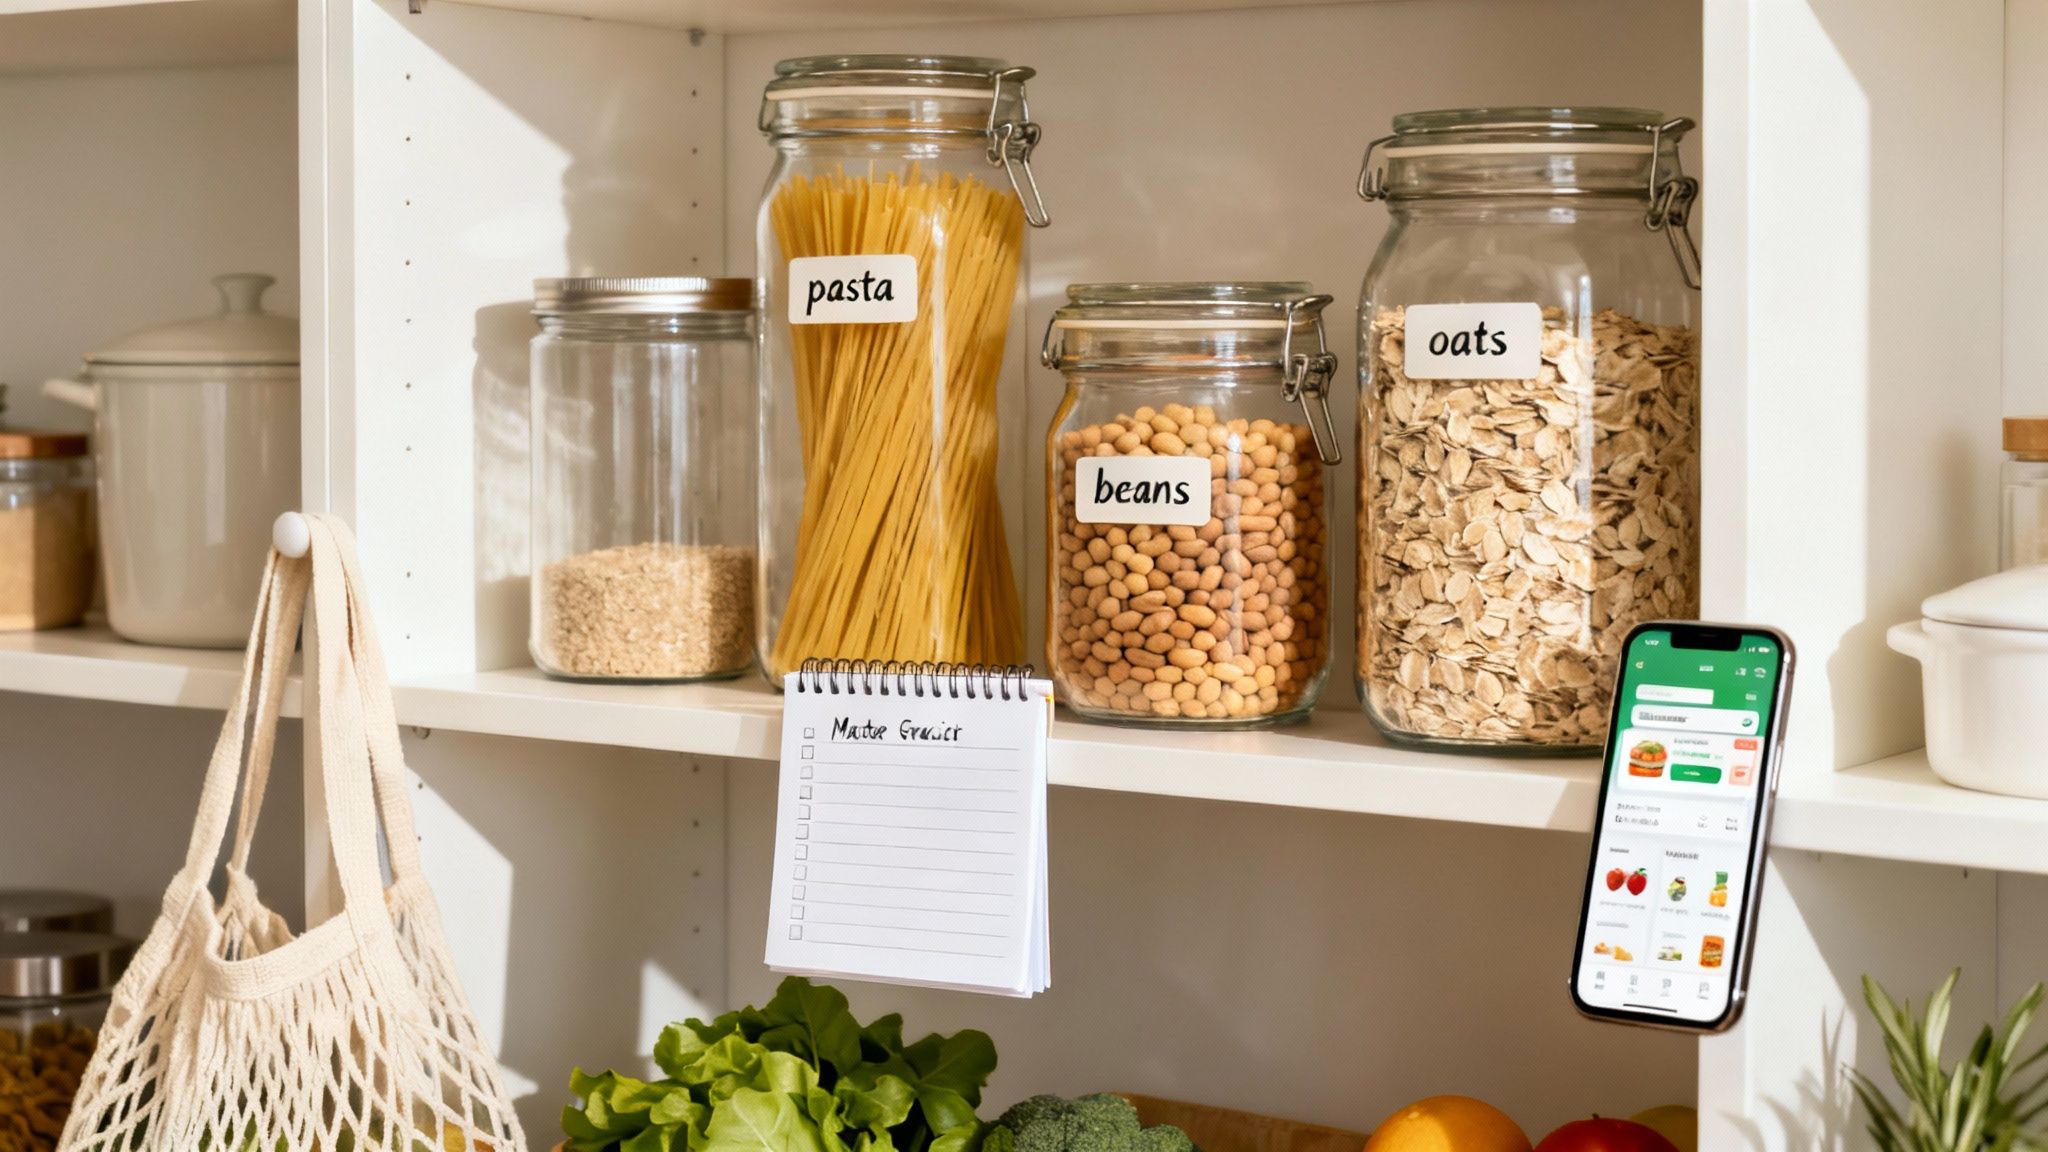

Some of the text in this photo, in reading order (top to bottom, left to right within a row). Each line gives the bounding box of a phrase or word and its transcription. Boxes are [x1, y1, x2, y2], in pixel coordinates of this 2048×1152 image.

[805, 271, 896, 316] pasta
[1427, 321, 1508, 357] oats
[1093, 467, 1191, 505] beans
